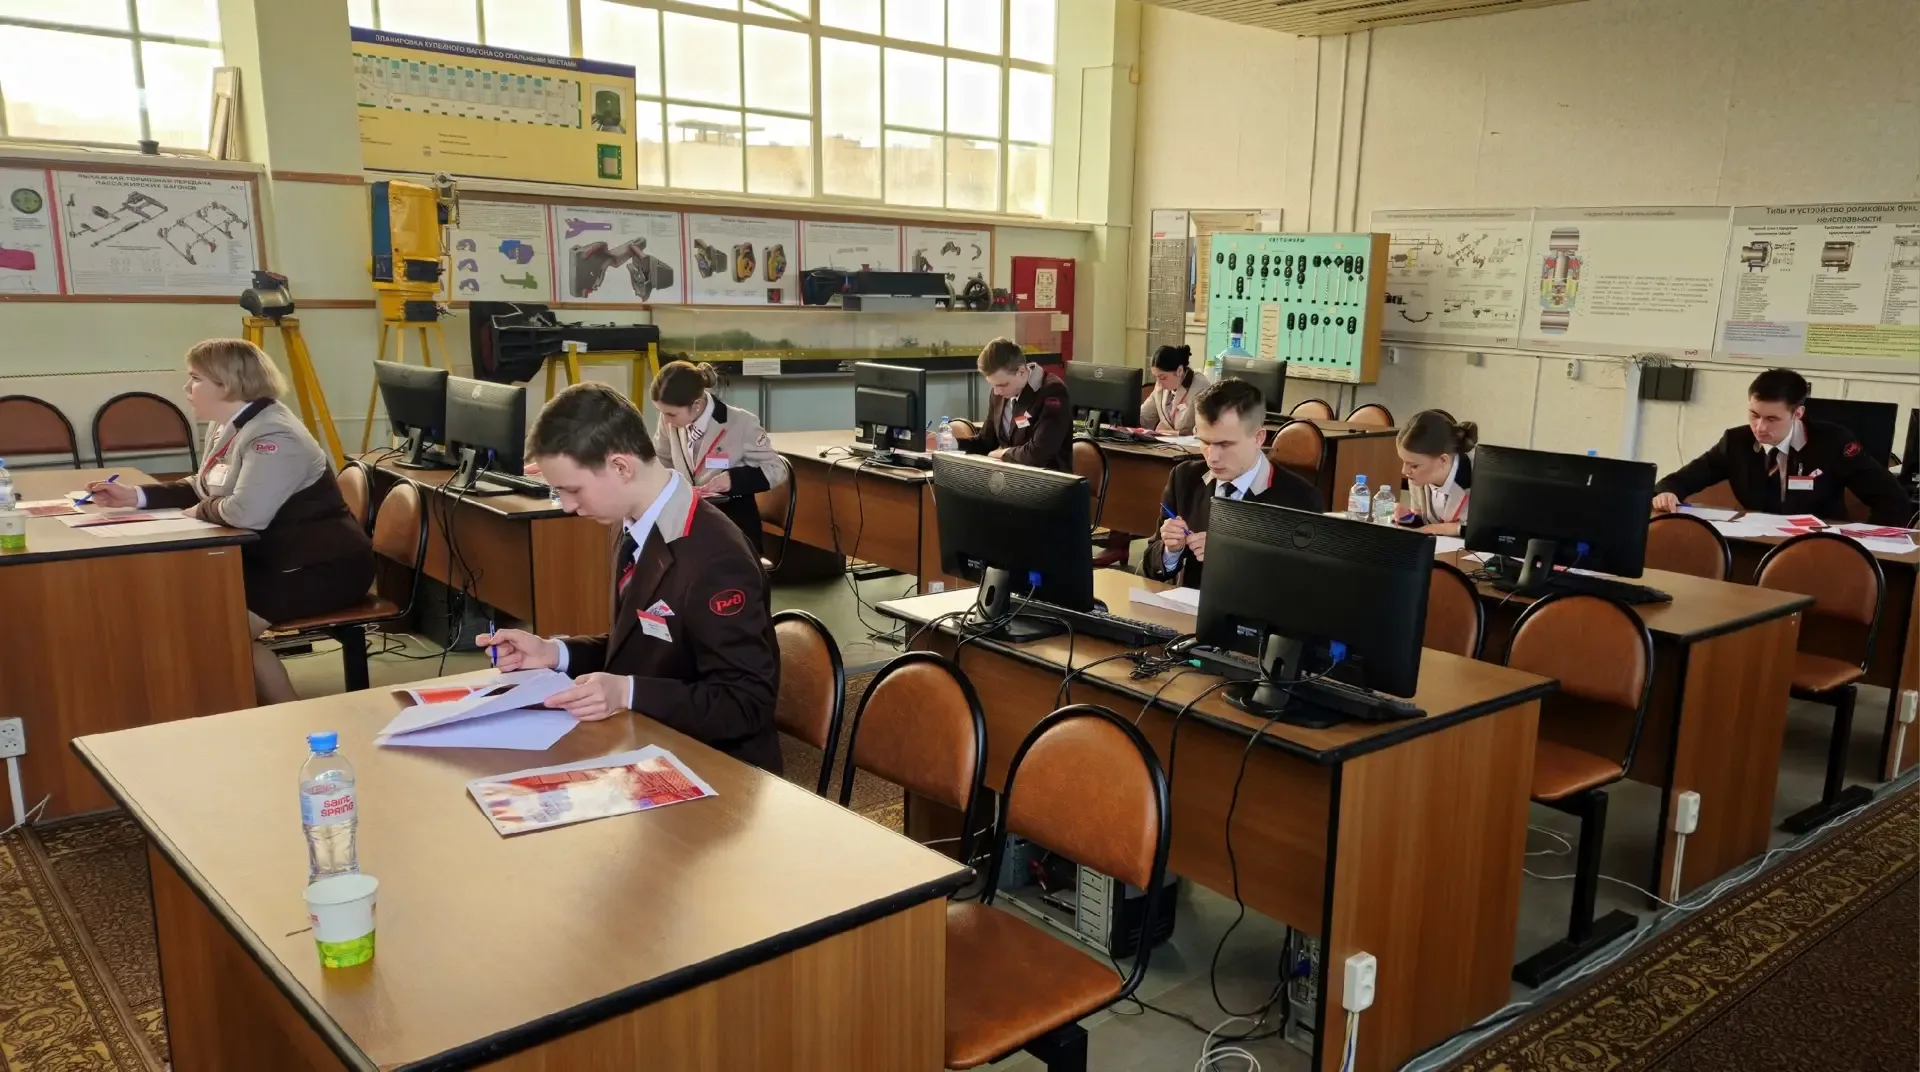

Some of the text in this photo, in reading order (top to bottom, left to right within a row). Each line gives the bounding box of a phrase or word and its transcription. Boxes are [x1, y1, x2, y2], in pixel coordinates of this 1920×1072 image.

[375, 34, 577, 68] ПЛАНИРОВКА КУПЕЙНОГО ВАГОНА СО СПАЛЬНЫМИ МЕСТАМИ
[1766, 207, 1787, 215] Типы
[1798, 205, 1844, 216] устройство
[1846, 205, 1895, 214] роликовых
